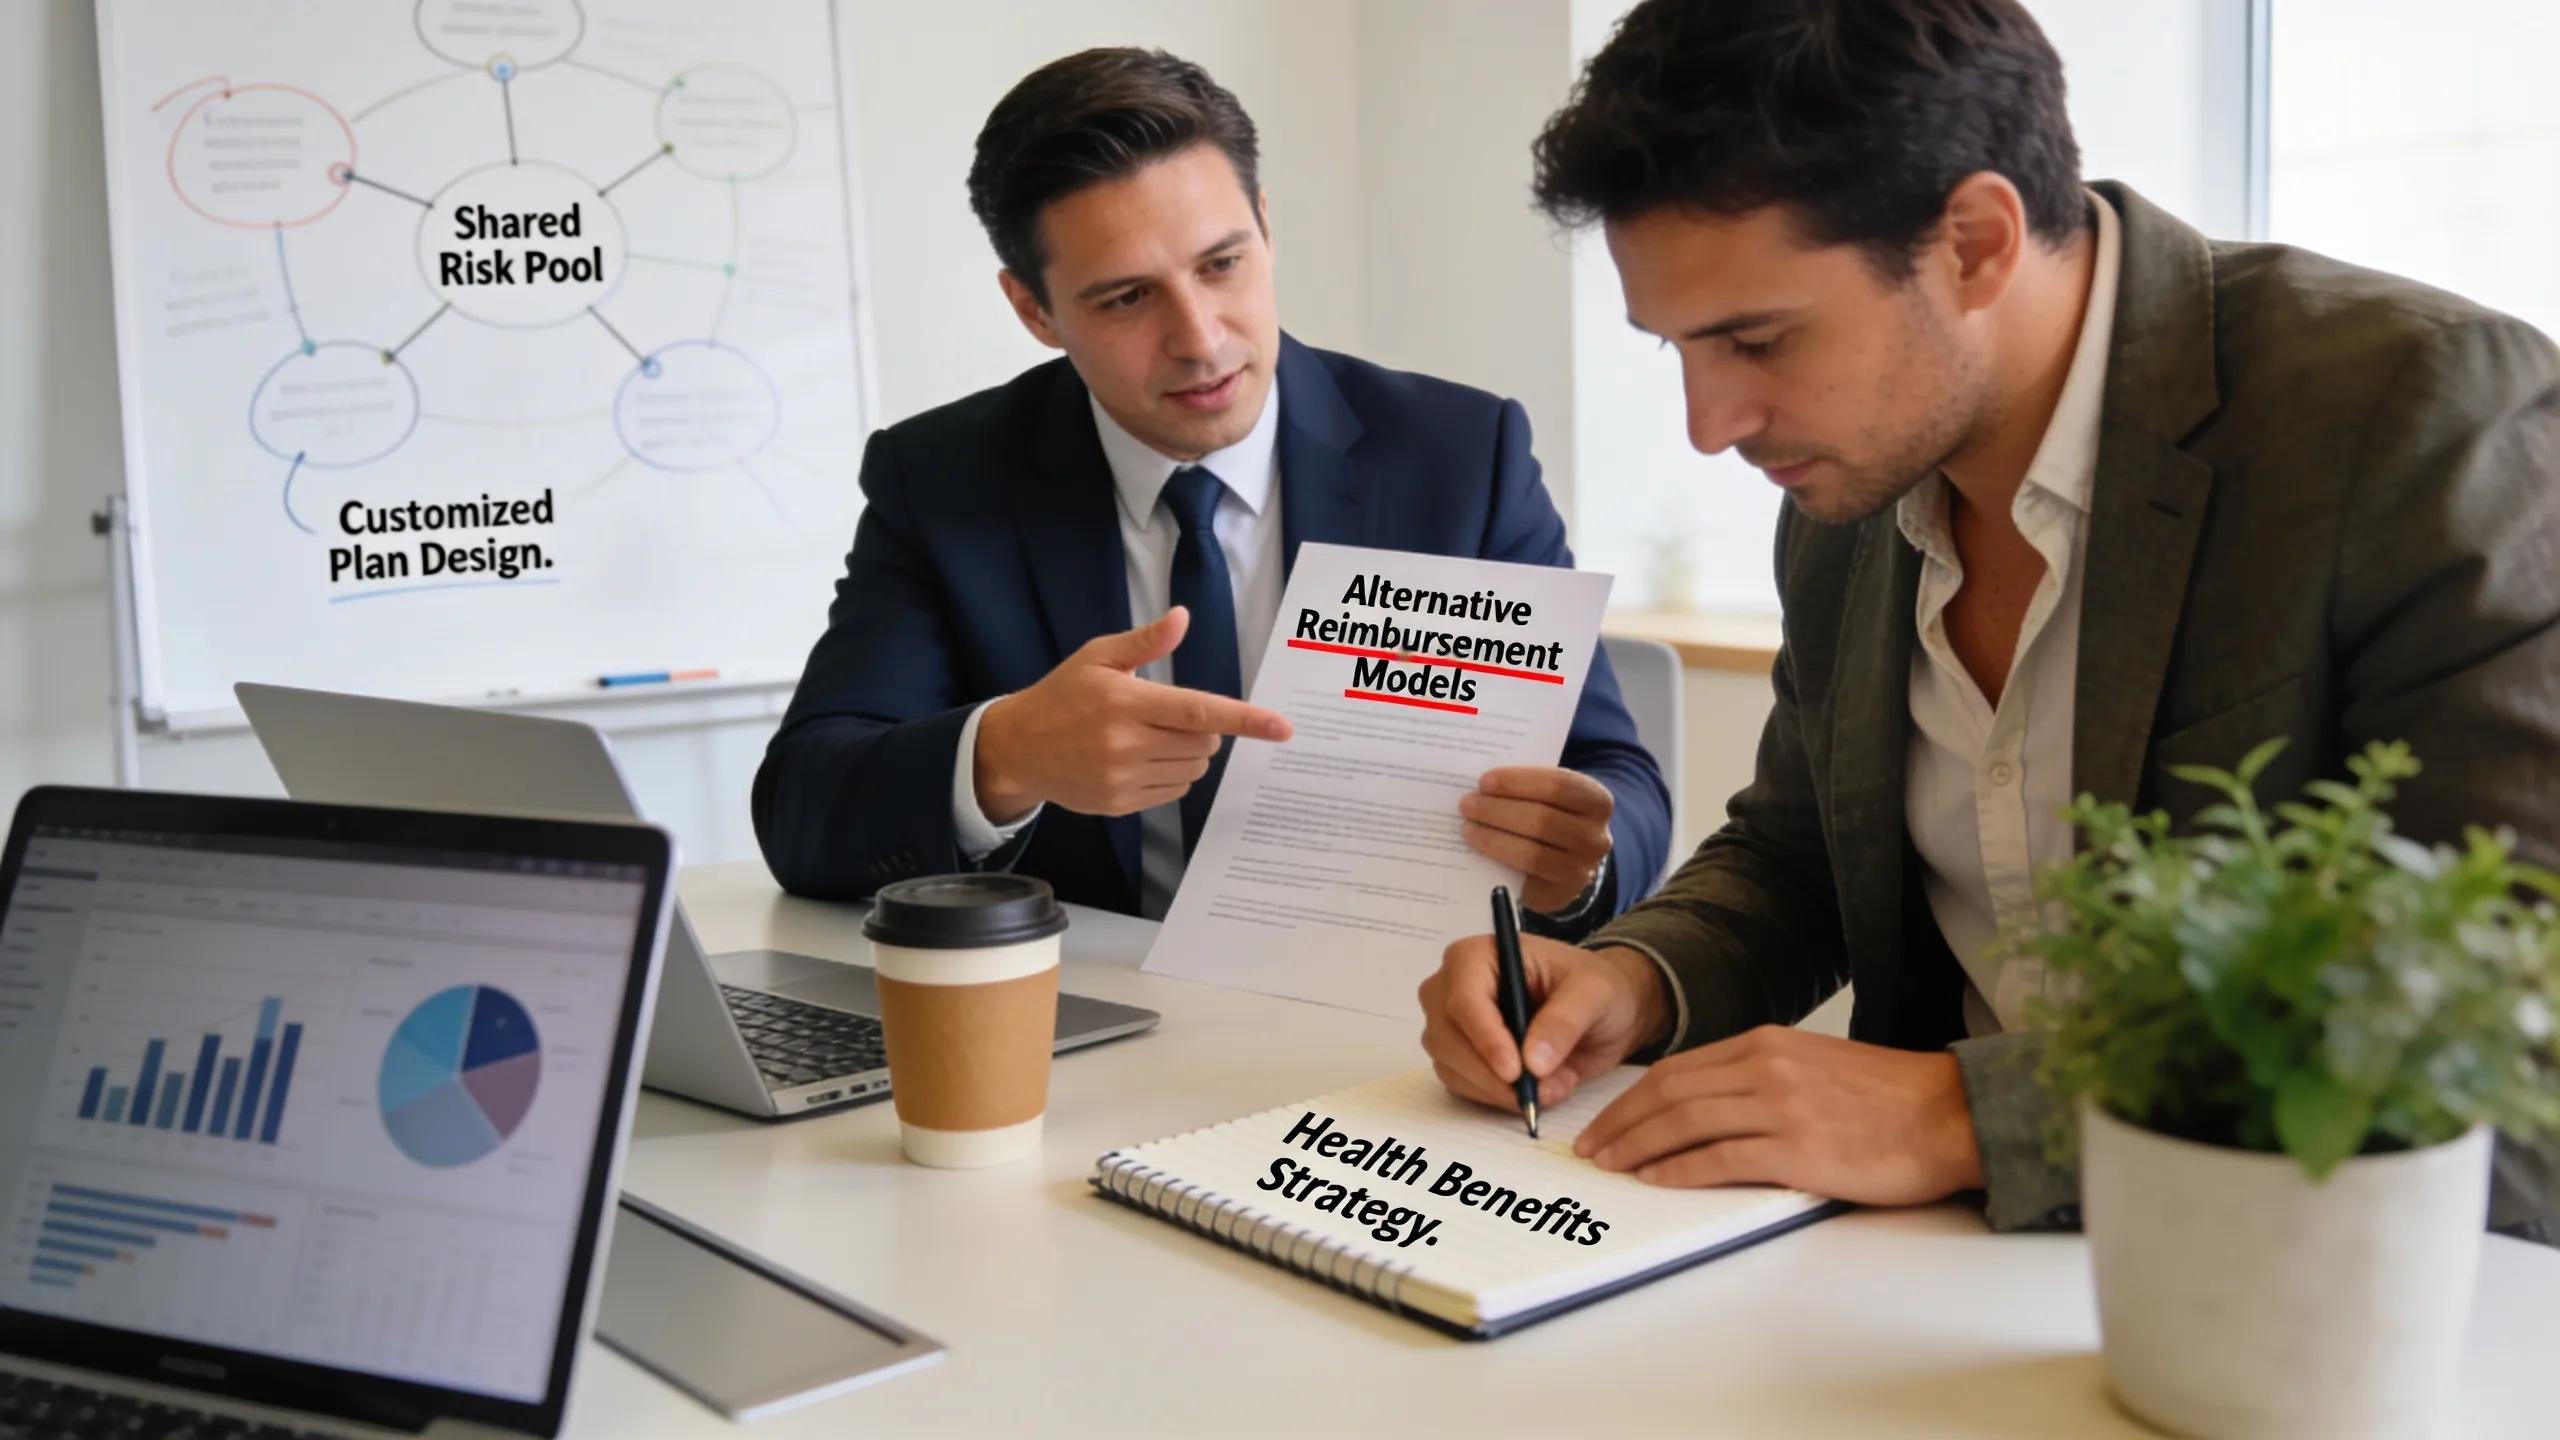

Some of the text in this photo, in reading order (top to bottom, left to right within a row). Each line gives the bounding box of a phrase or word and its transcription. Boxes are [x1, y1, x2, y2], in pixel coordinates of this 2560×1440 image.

[454, 202, 582, 240] Shared
[439, 246, 604, 287] Risk Pool
[338, 488, 554, 535] Customized
[328, 541, 554, 583] Plan Design.
[1340, 573, 1533, 627] Alternative
[1295, 607, 1565, 672] Reimbursement
[1351, 655, 1478, 703] Models
[1255, 1156, 1442, 1249] Strategy.
[1281, 1110, 1612, 1248] Health Benefits
